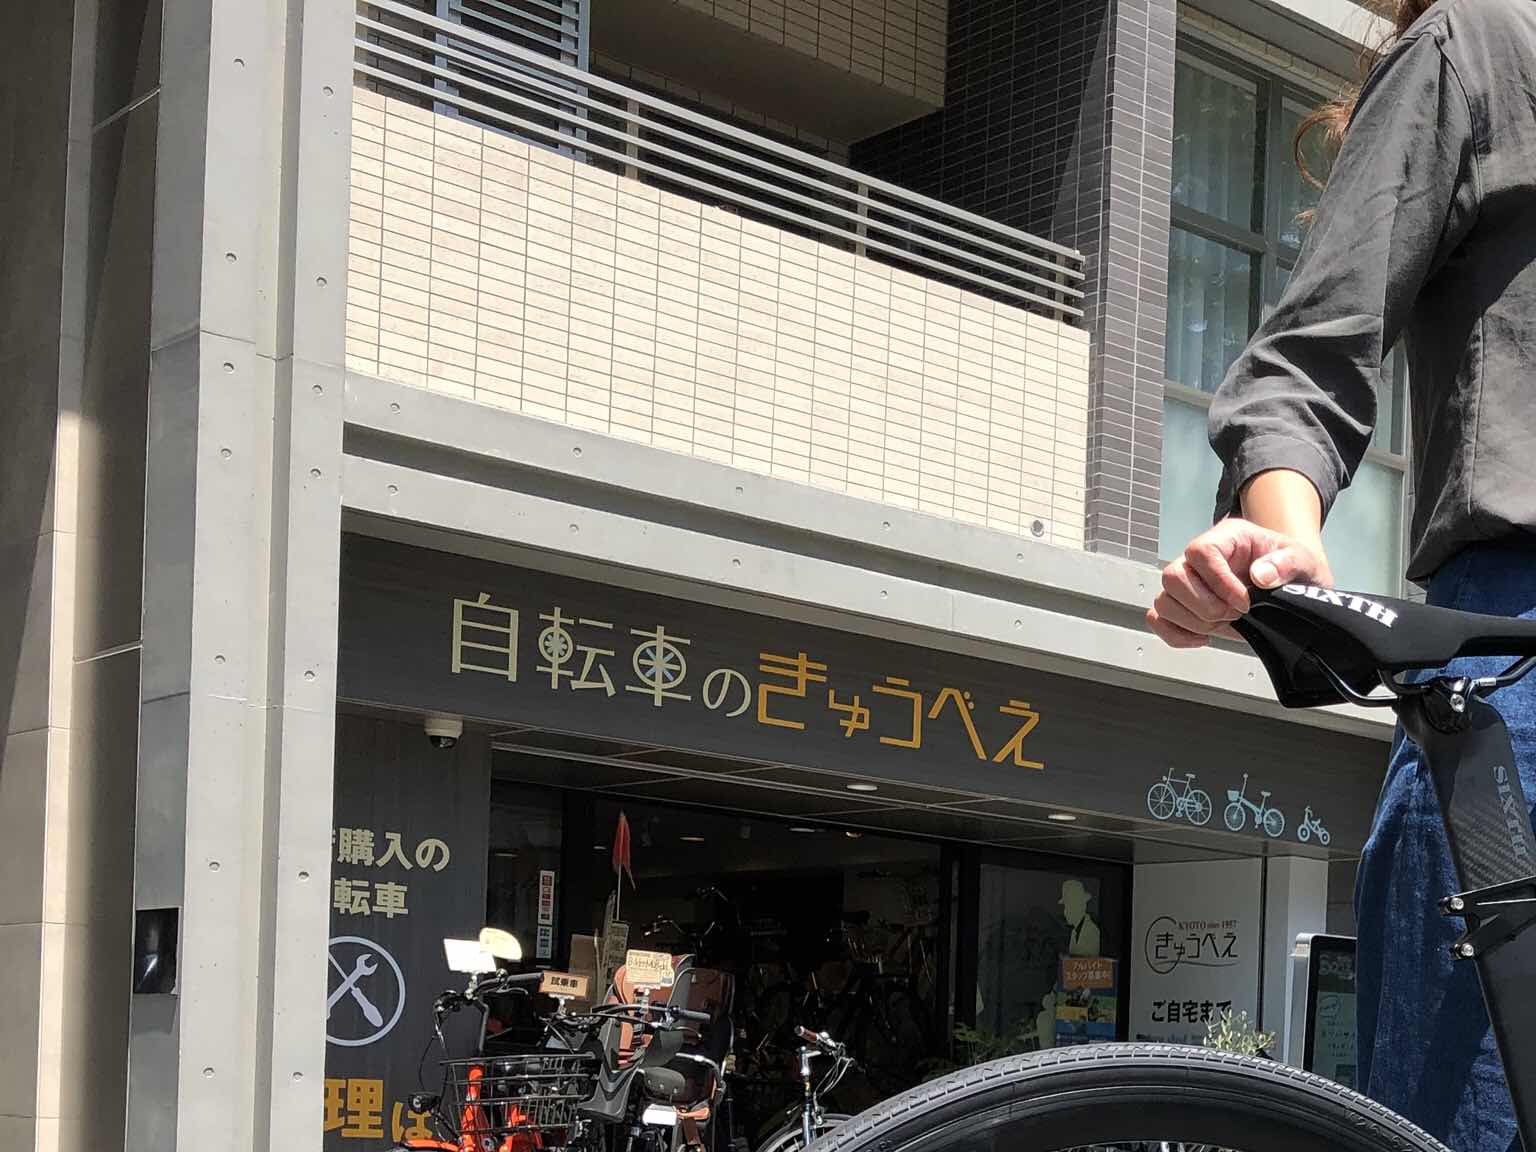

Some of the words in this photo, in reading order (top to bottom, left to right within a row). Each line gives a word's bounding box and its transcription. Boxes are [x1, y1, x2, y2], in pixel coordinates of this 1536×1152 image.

[1283, 585, 1398, 627] SIXTH
[1493, 765, 1529, 860] SIXTH
[1155, 932, 1238, 960] きゅうべえ
